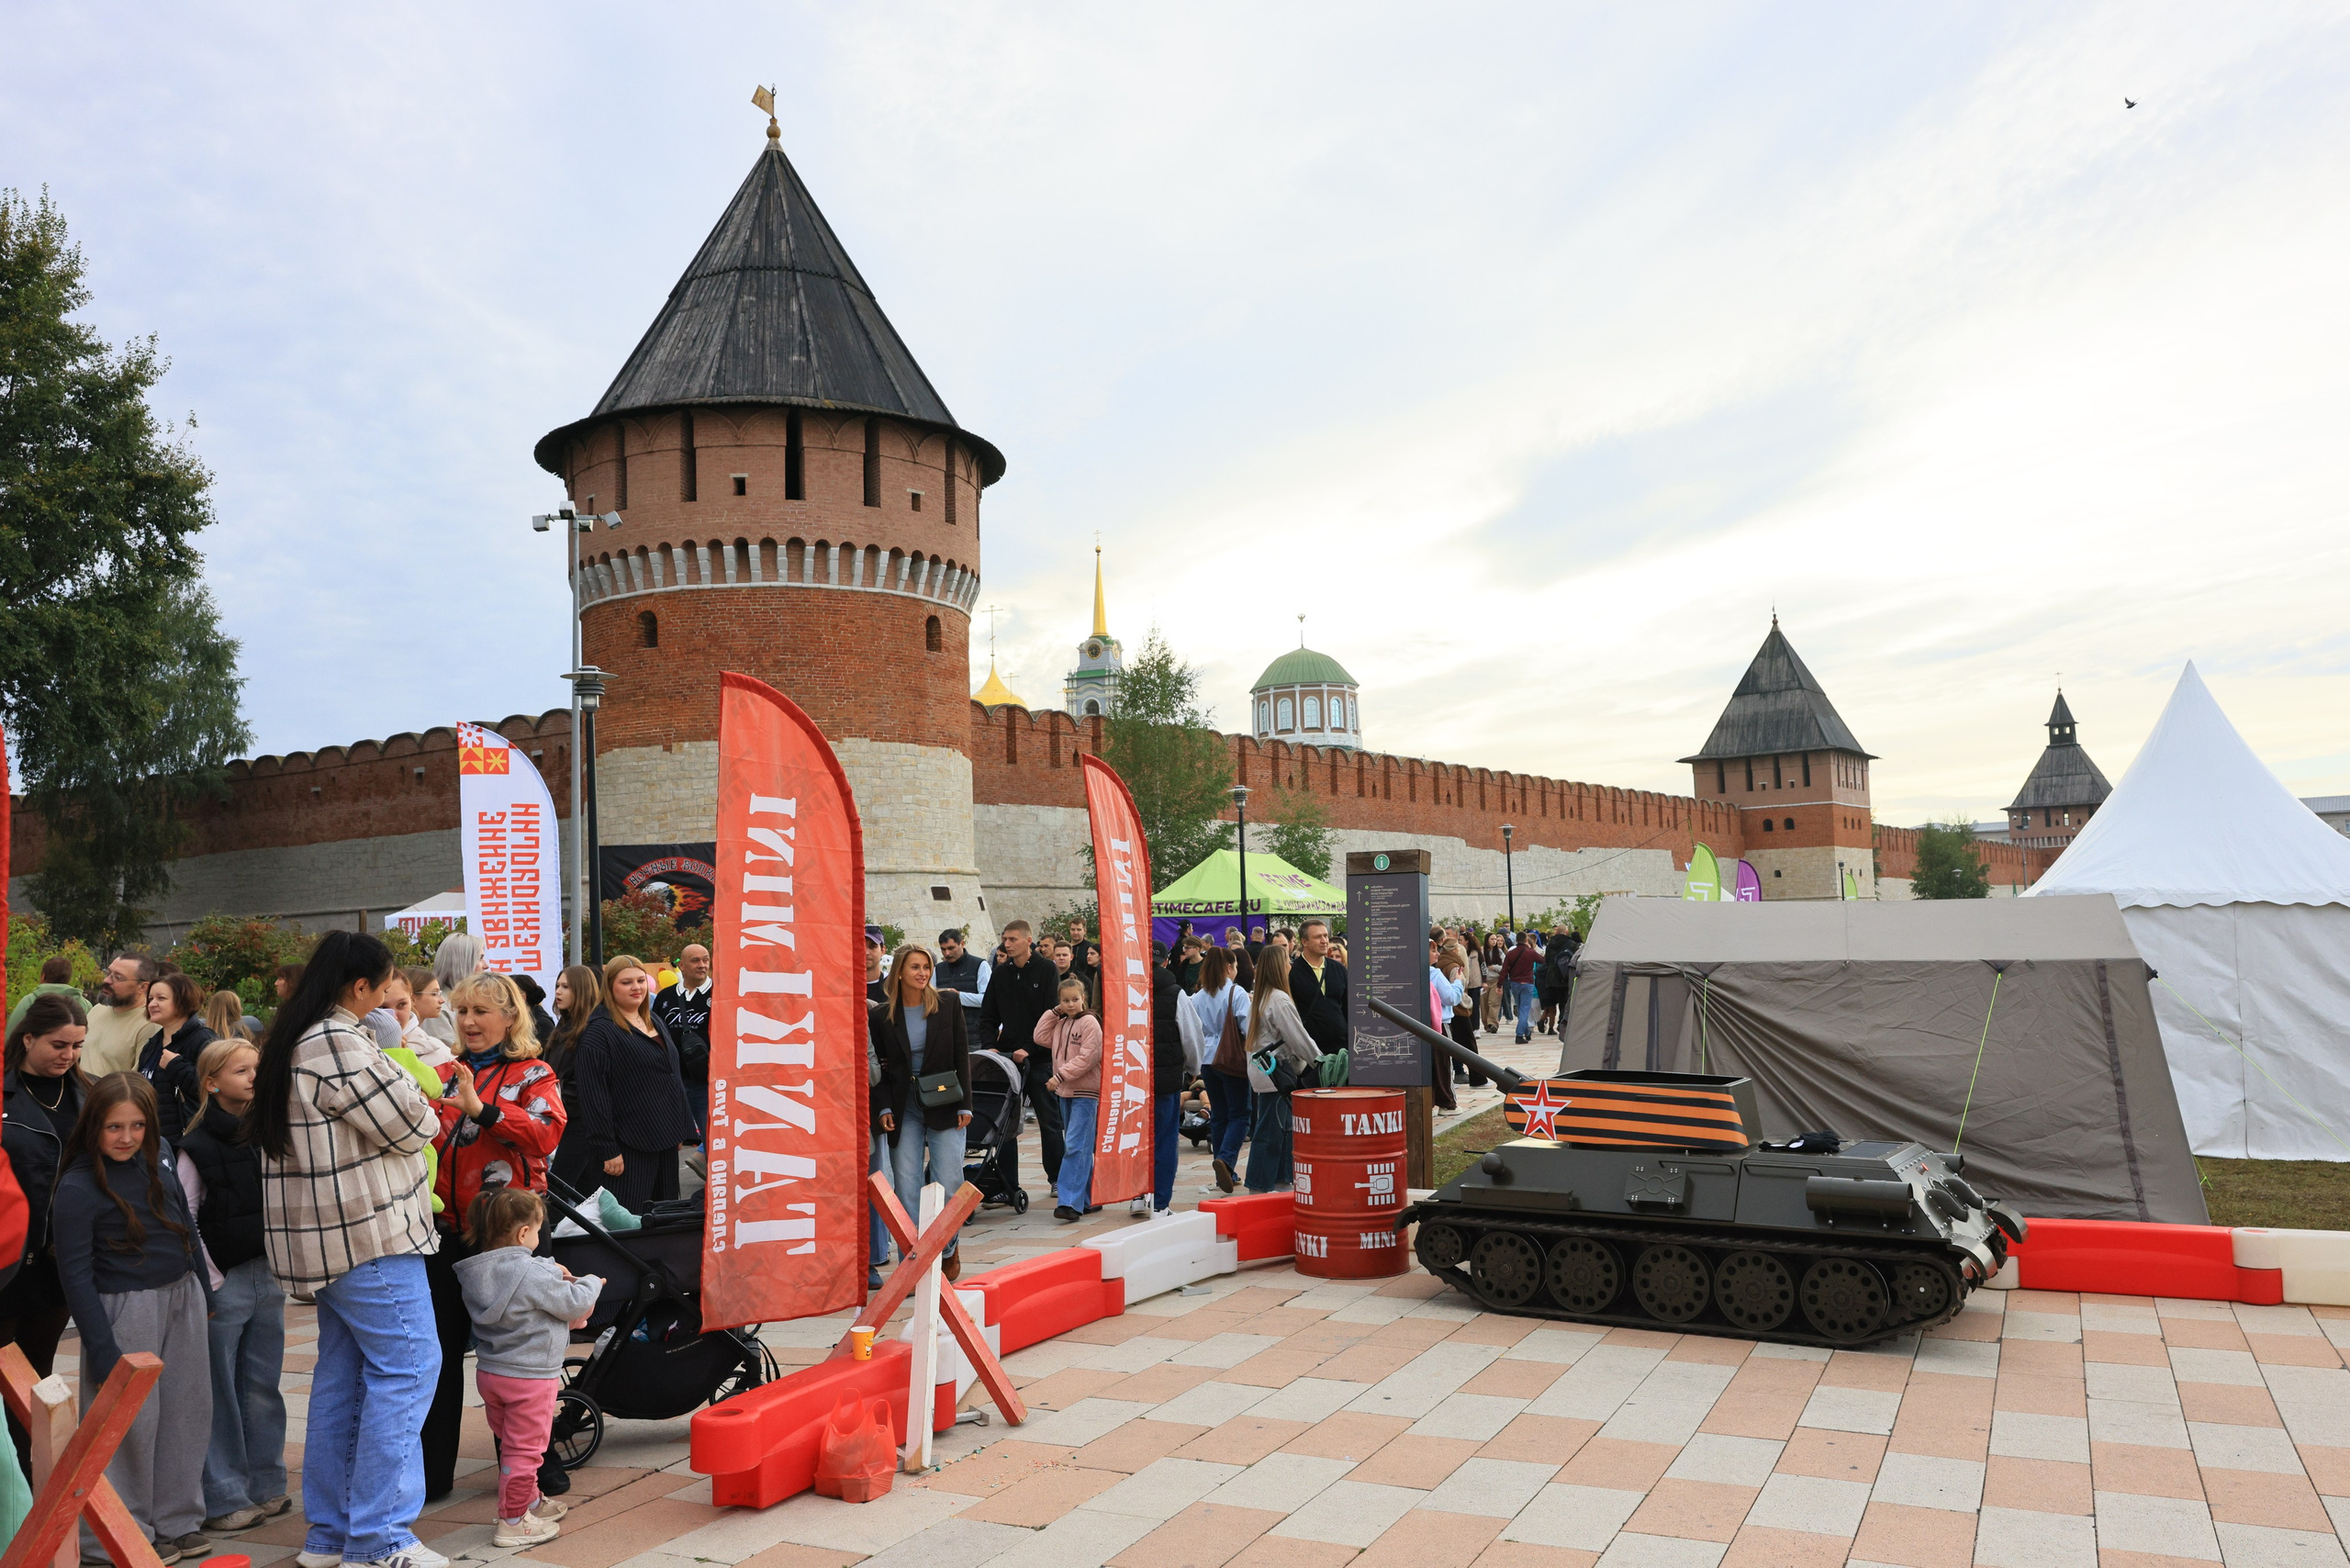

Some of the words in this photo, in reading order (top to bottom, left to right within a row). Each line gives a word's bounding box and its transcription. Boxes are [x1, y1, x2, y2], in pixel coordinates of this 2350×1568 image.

[628, 858, 677, 887] НОЧНЫЕ
[1340, 1110, 1403, 1136] TANKI
[1360, 1230, 1396, 1249] MINI
